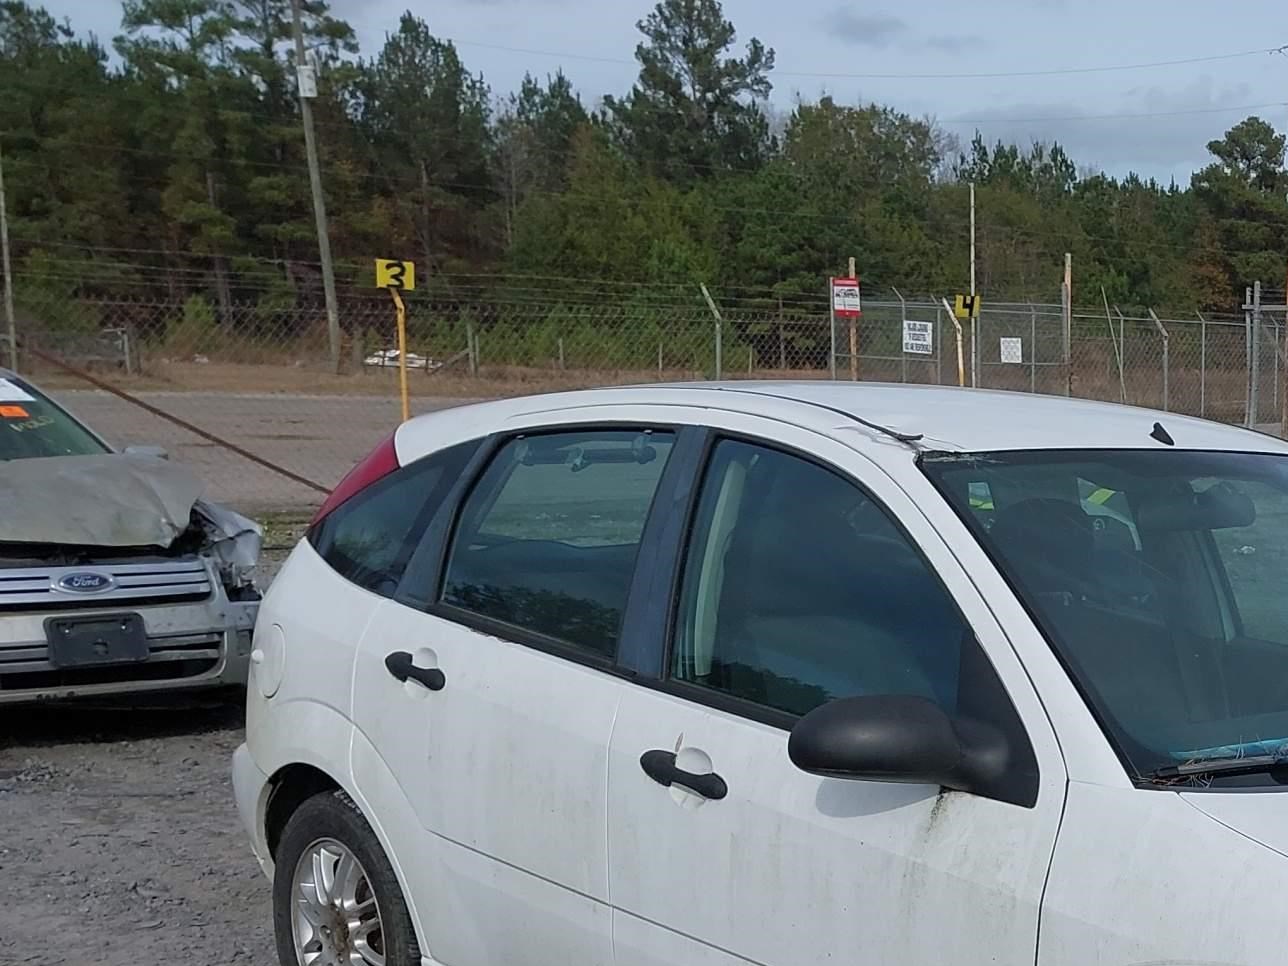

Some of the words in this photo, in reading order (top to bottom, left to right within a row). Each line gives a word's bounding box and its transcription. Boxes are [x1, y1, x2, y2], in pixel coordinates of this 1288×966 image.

[384, 262, 406, 289] 3
[962, 295, 976, 317] 4
[71, 575, 100, 588] Ford
